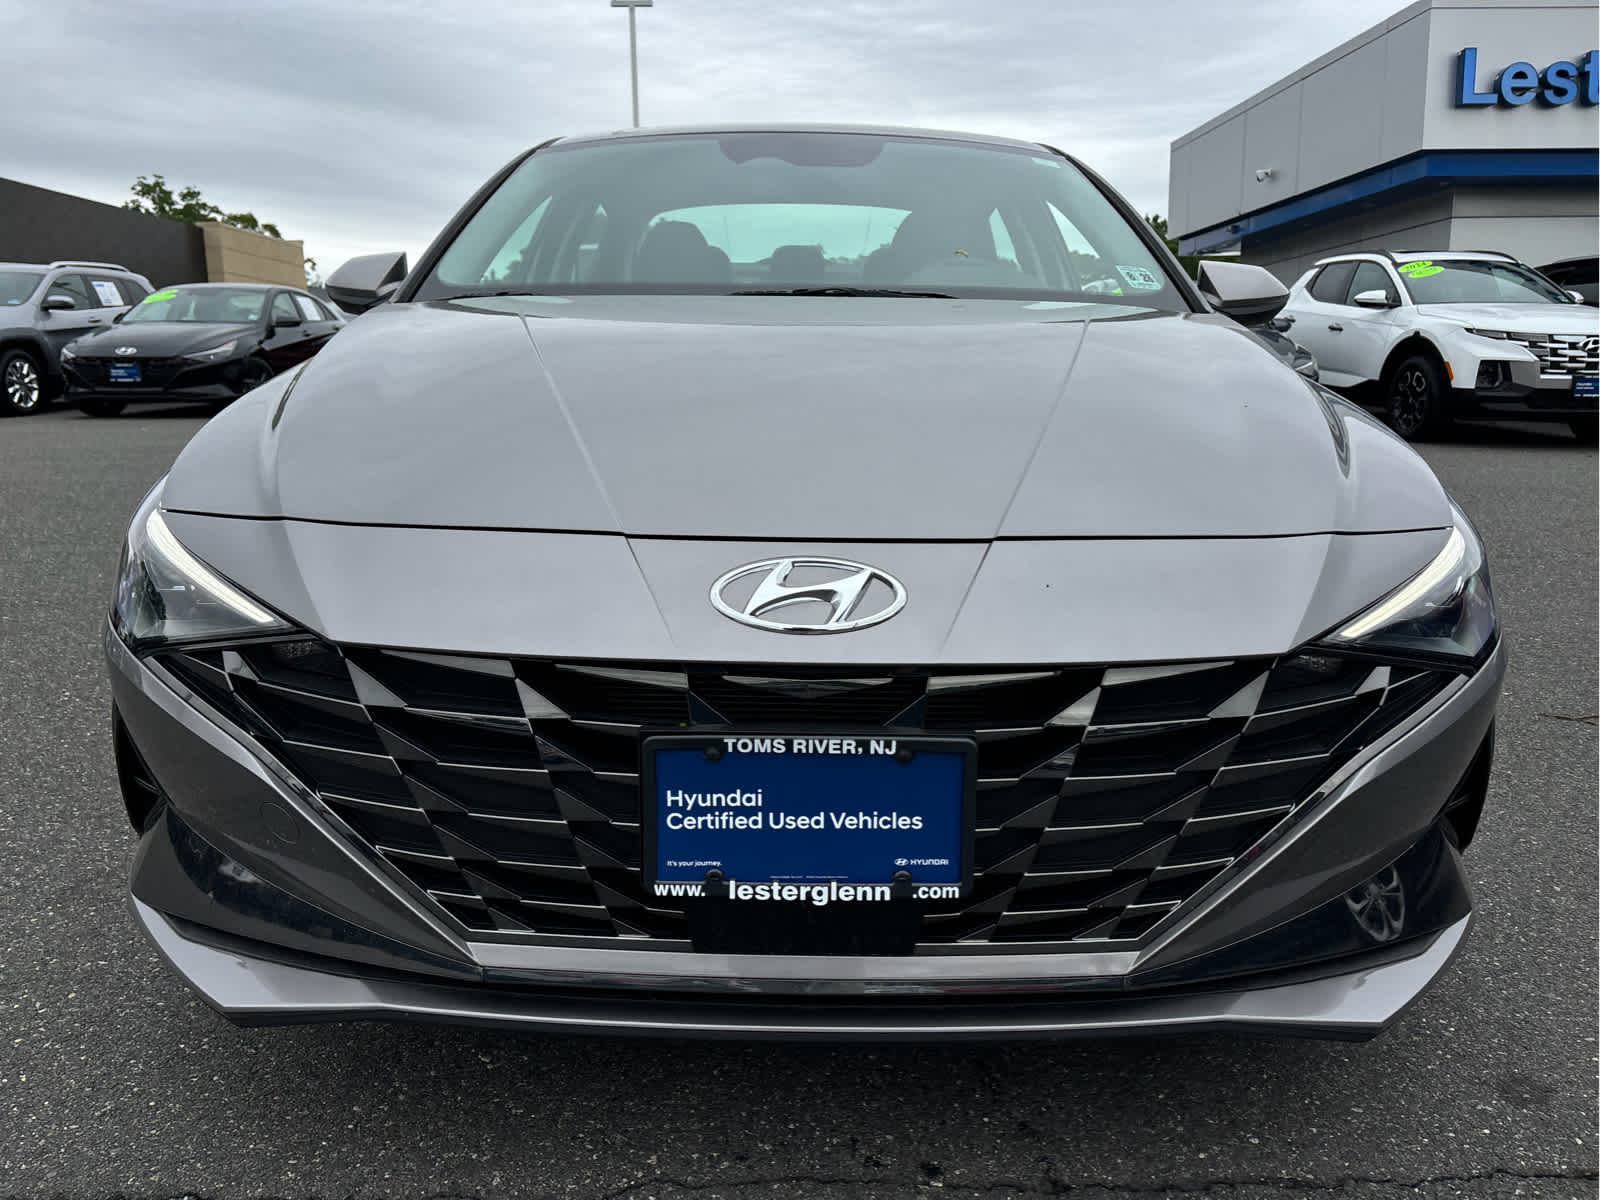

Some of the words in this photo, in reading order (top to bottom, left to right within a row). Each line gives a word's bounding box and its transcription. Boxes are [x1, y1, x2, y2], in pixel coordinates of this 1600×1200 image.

[723, 738, 786, 754] TOMS
[793, 739, 863, 755] RIVER,
[870, 739, 897, 755] NJ
[666, 788, 763, 810] Hyundai
[666, 811, 763, 830] Certified
[769, 811, 825, 830] Used
[830, 811, 924, 830] Vehicles
[694, 860, 723, 868] journey.
[909, 858, 950, 866] HYUNDAI
[653, 884, 706, 897] www.
[729, 880, 891, 906] lesterglenn
[911, 885, 960, 899] .com
